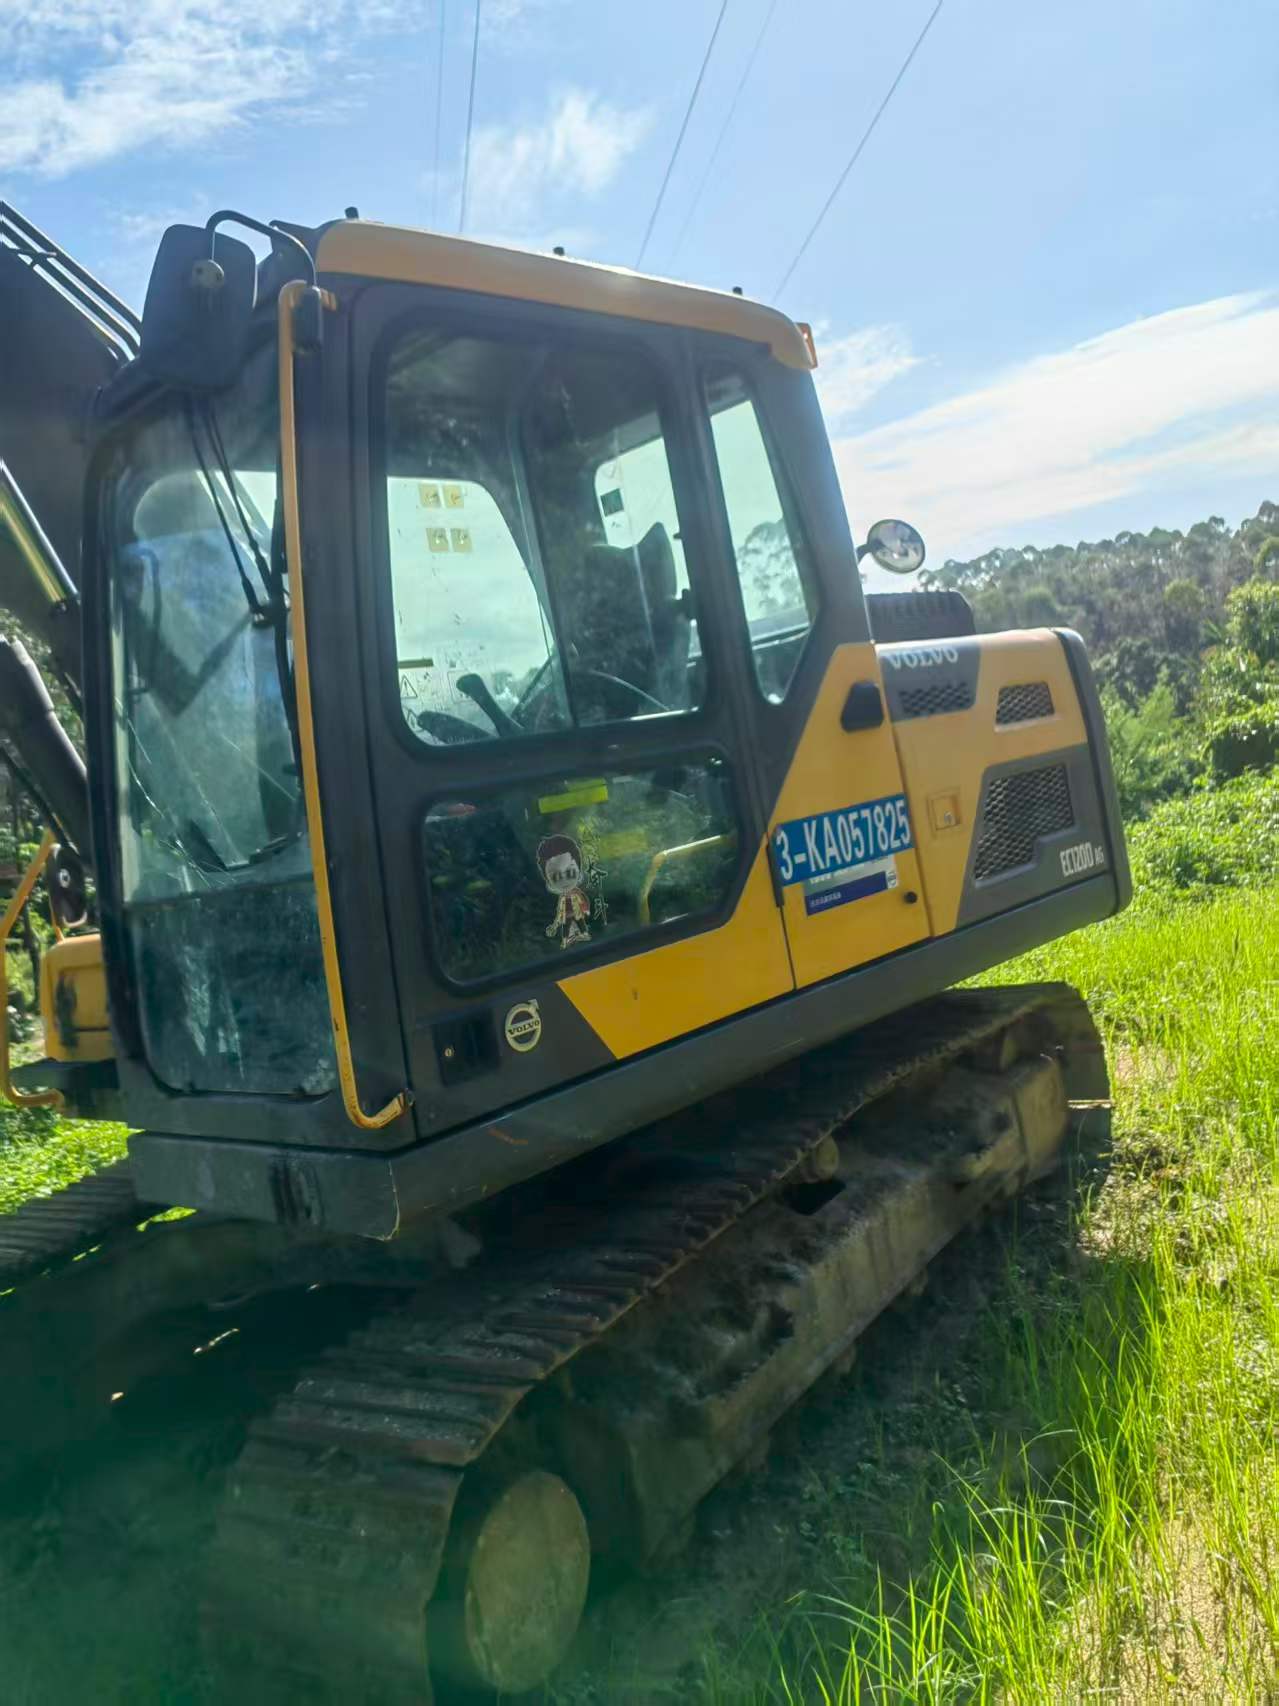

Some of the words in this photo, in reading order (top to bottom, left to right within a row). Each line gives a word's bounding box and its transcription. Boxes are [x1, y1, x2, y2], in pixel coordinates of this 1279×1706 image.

[887, 647, 959, 670] VOLVO
[775, 799, 911, 881] 3-KA057825
[508, 1019, 540, 1036] VOLVO
